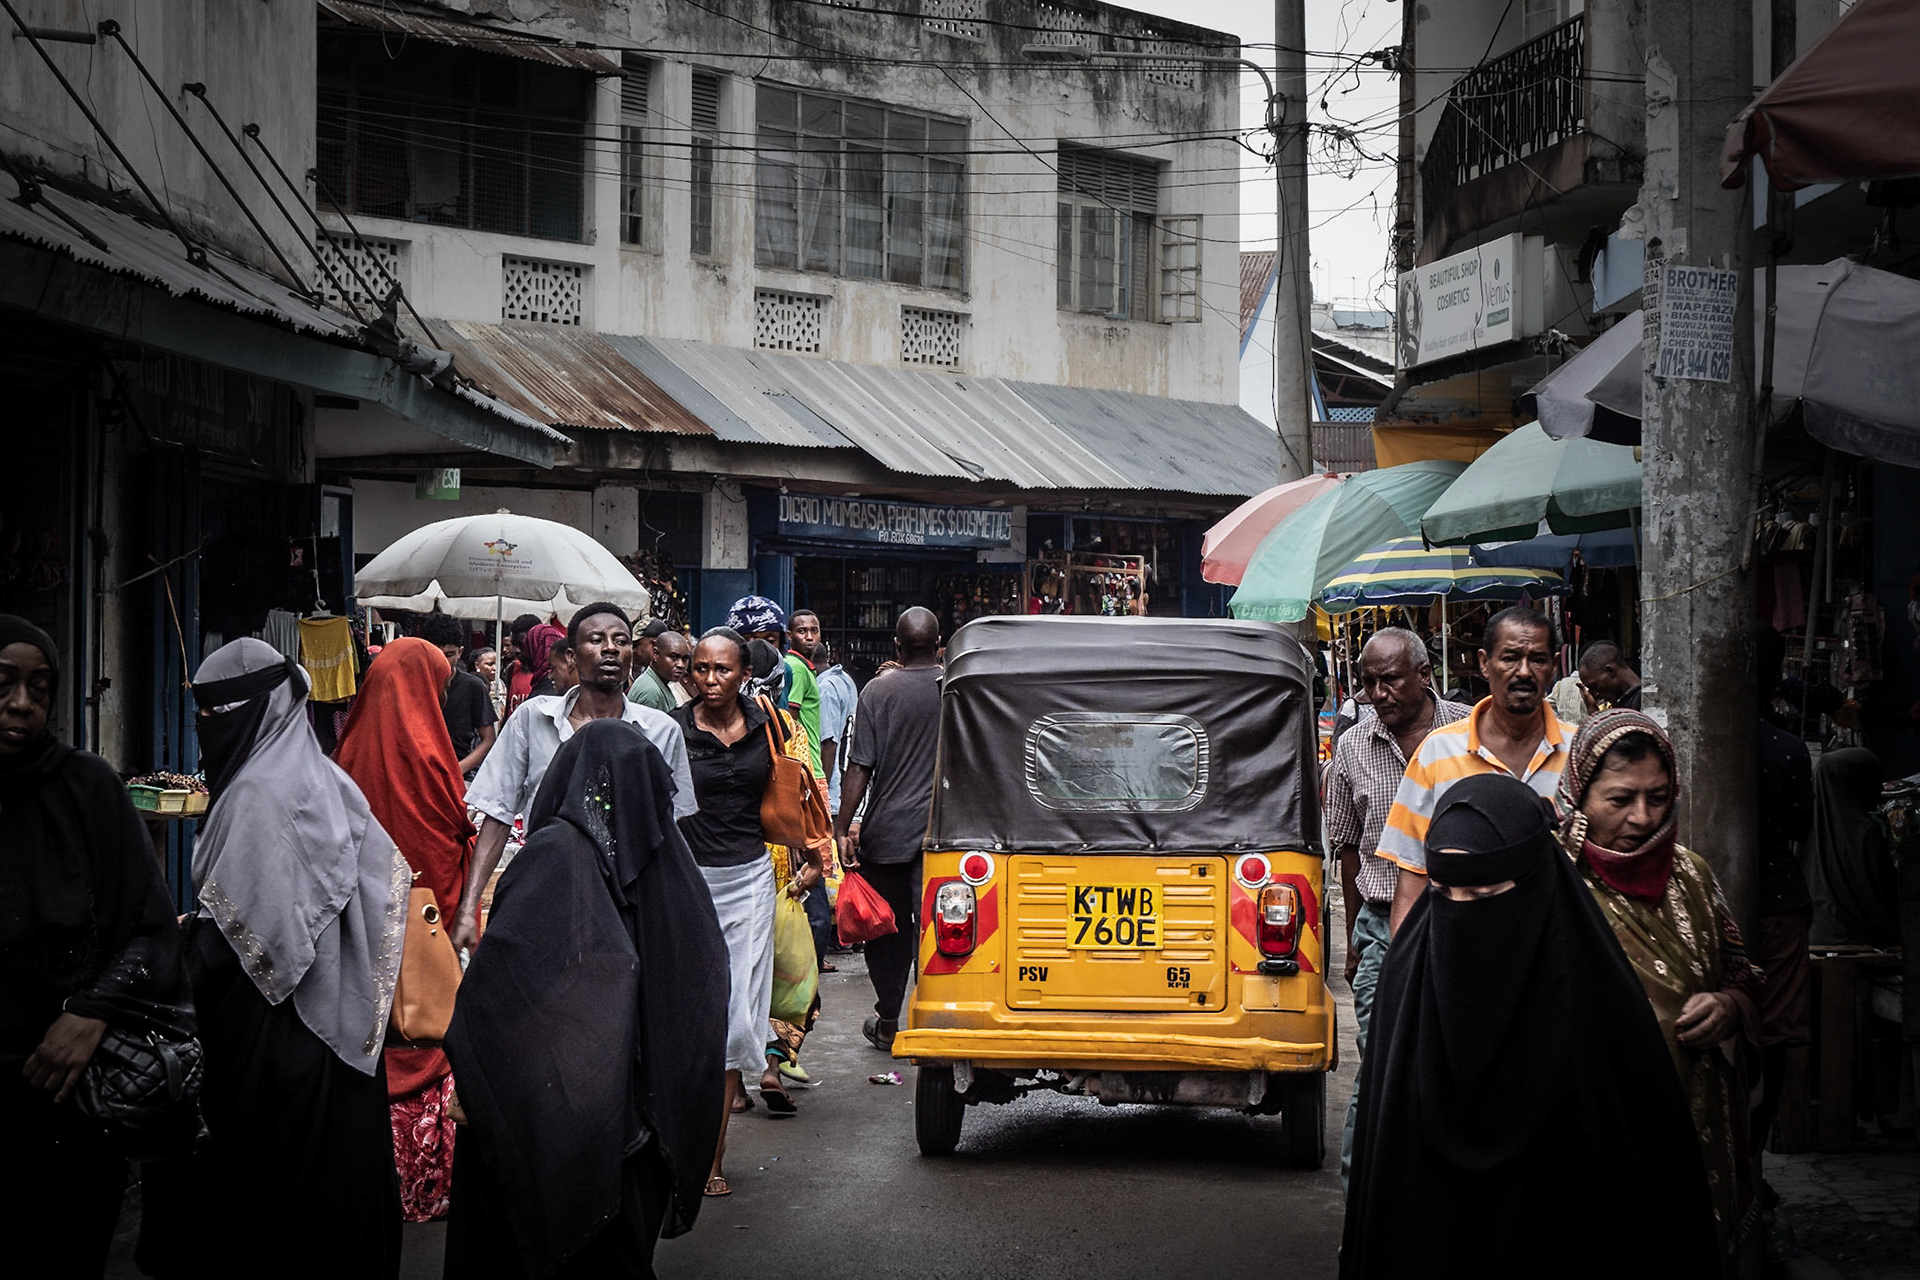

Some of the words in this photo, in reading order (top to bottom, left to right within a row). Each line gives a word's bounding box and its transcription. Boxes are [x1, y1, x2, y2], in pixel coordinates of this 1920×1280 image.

[1429, 268, 1460, 290] BEAUTIFUL
[1461, 259, 1478, 279] SHOP
[1667, 269, 1736, 292] BROTHER
[1437, 287, 1470, 311] COSMETICS
[1484, 281, 1511, 308] Venus
[1671, 312, 1732, 324] BIASHARA
[1672, 302, 1734, 315] MAPENZI
[1669, 329, 1709, 340] KUSHIKA
[1712, 332, 1732, 342] WEZI
[1670, 321, 1696, 330] NGUVU
[1698, 322, 1708, 330] ZA
[1668, 339, 1695, 348] CHEO
[1698, 341, 1731, 352] KAZINI
[1660, 347, 1686, 377] 0715
[1688, 349, 1708, 378] 944
[1711, 351, 1731, 380] 626
[823, 499, 887, 531] MOMBASA
[887, 505, 945, 536] PERFUMES
[1074, 885, 1153, 916] KTWB
[1074, 917, 1156, 946] 760E
[1019, 966, 1049, 981] PSV
[1166, 966, 1191, 982] 65
